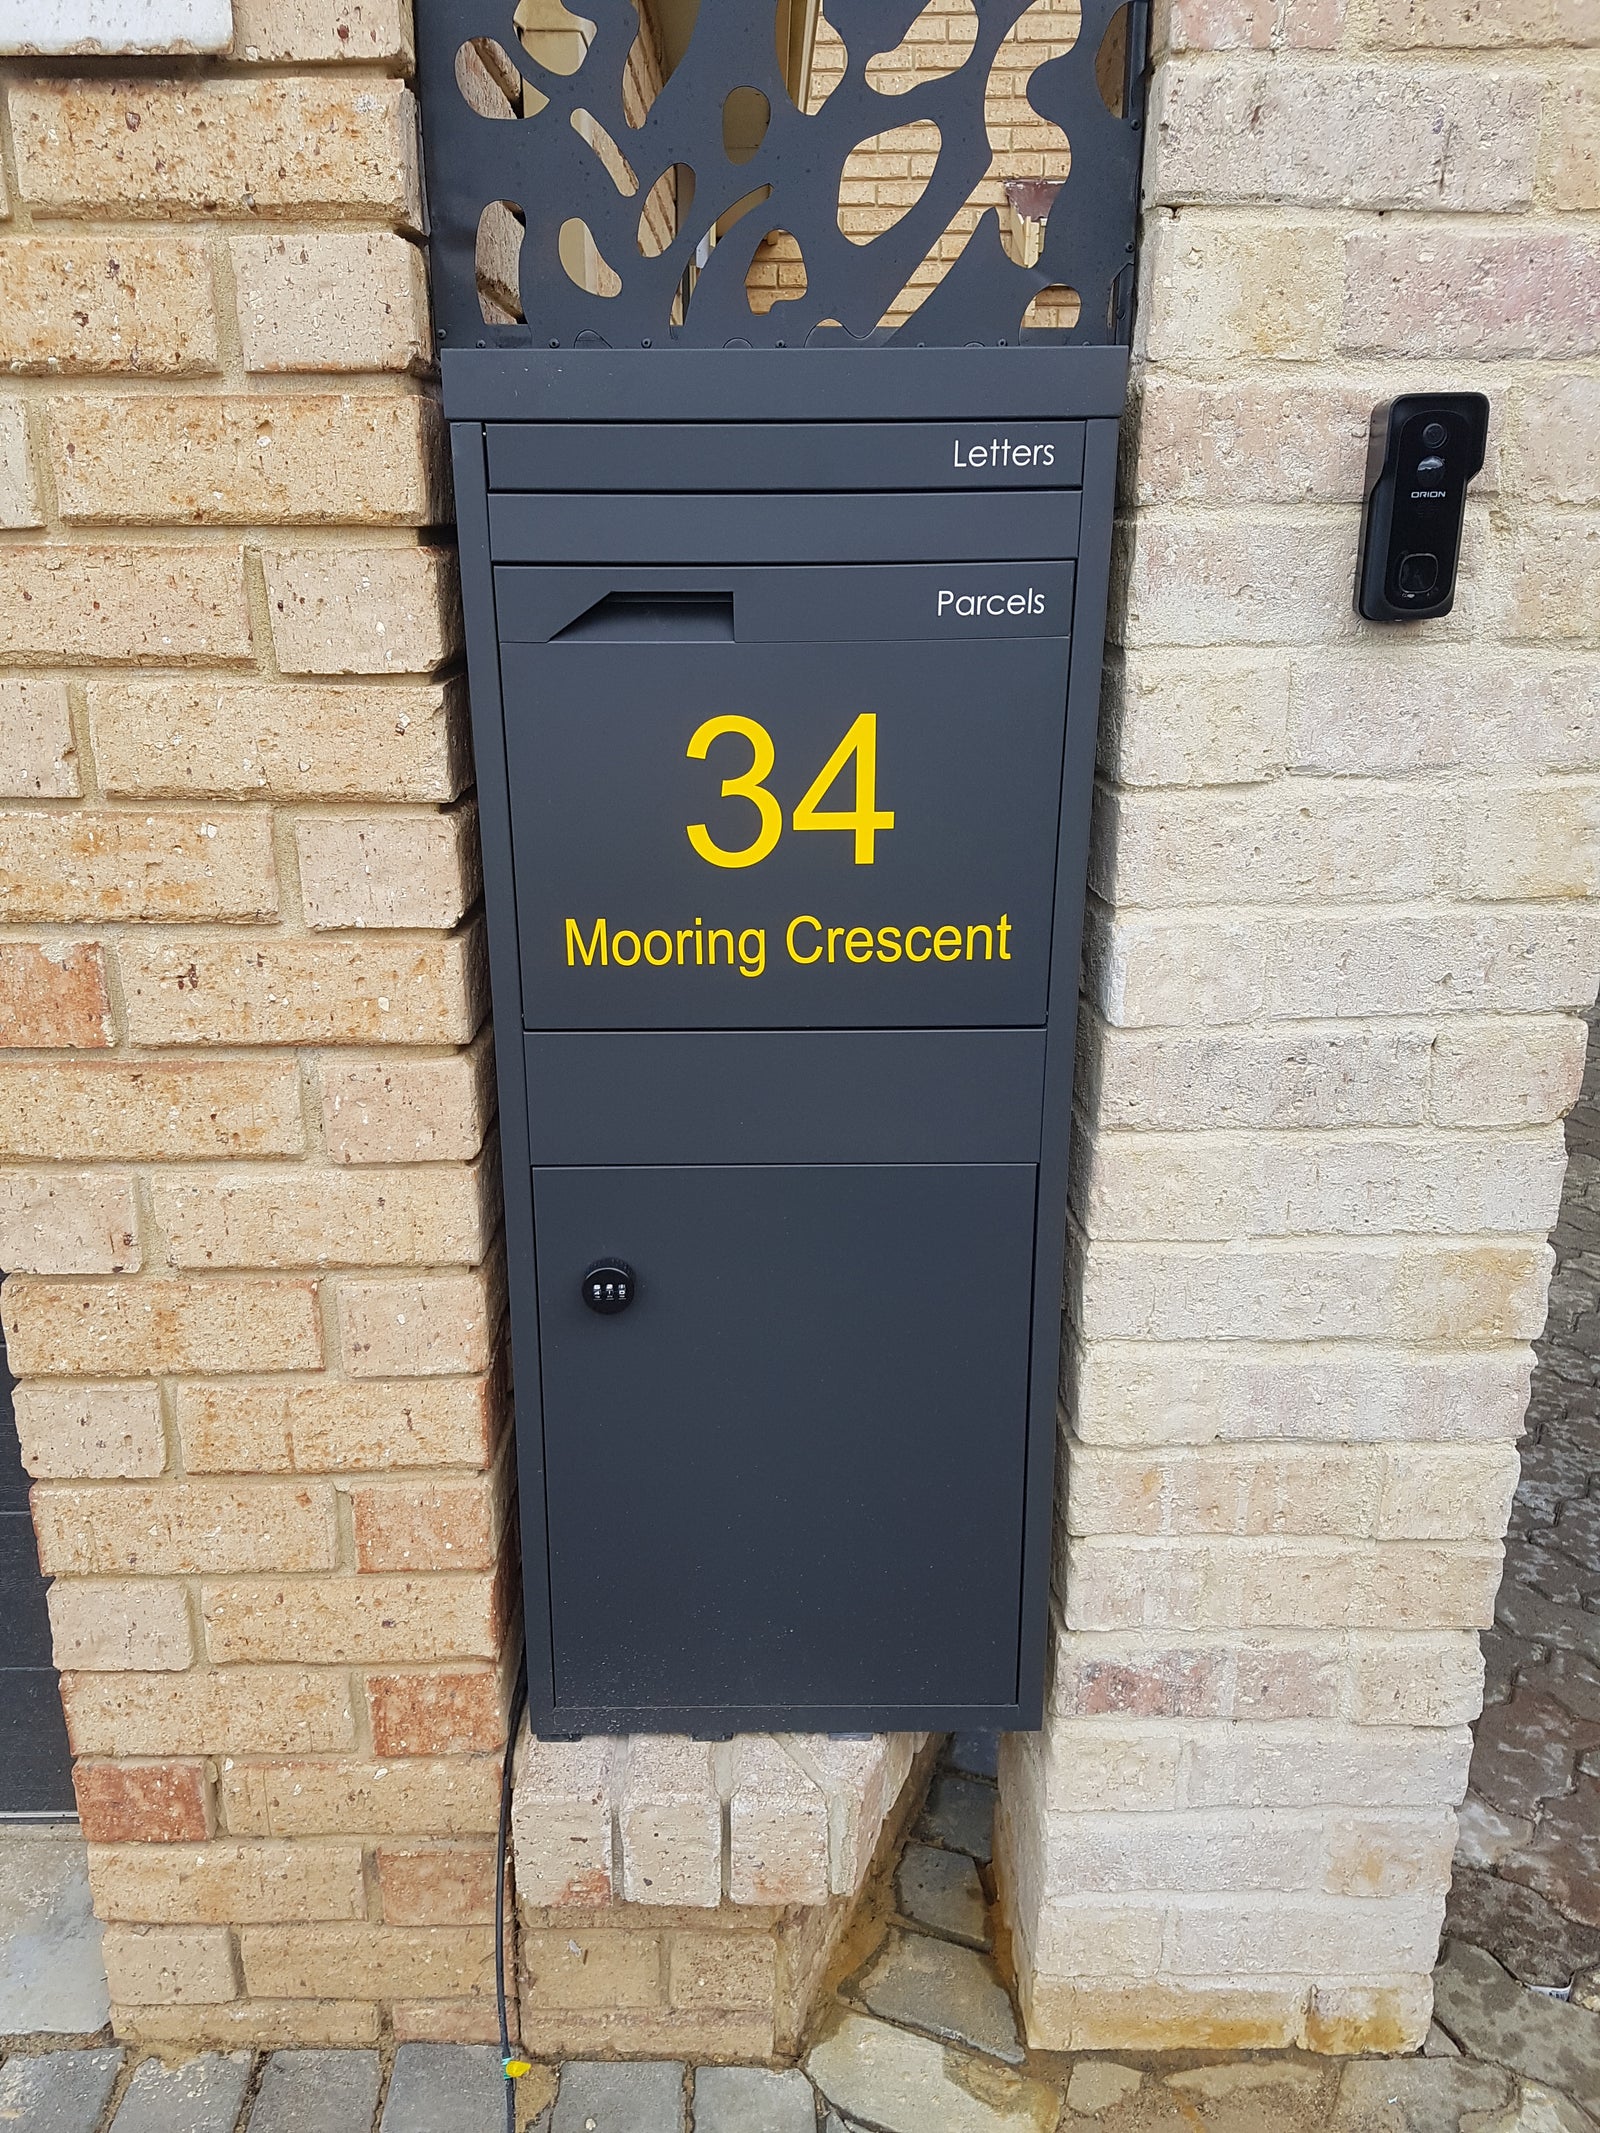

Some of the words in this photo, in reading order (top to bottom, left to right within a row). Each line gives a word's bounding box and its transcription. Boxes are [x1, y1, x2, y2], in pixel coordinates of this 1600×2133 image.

[953, 438, 1055, 467] Letters
[1410, 490, 1446, 498] ORION
[937, 587, 1045, 616] Parcels
[686, 712, 895, 868] 34
[564, 917, 767, 977] Mooring
[785, 913, 1012, 964] Crescent
